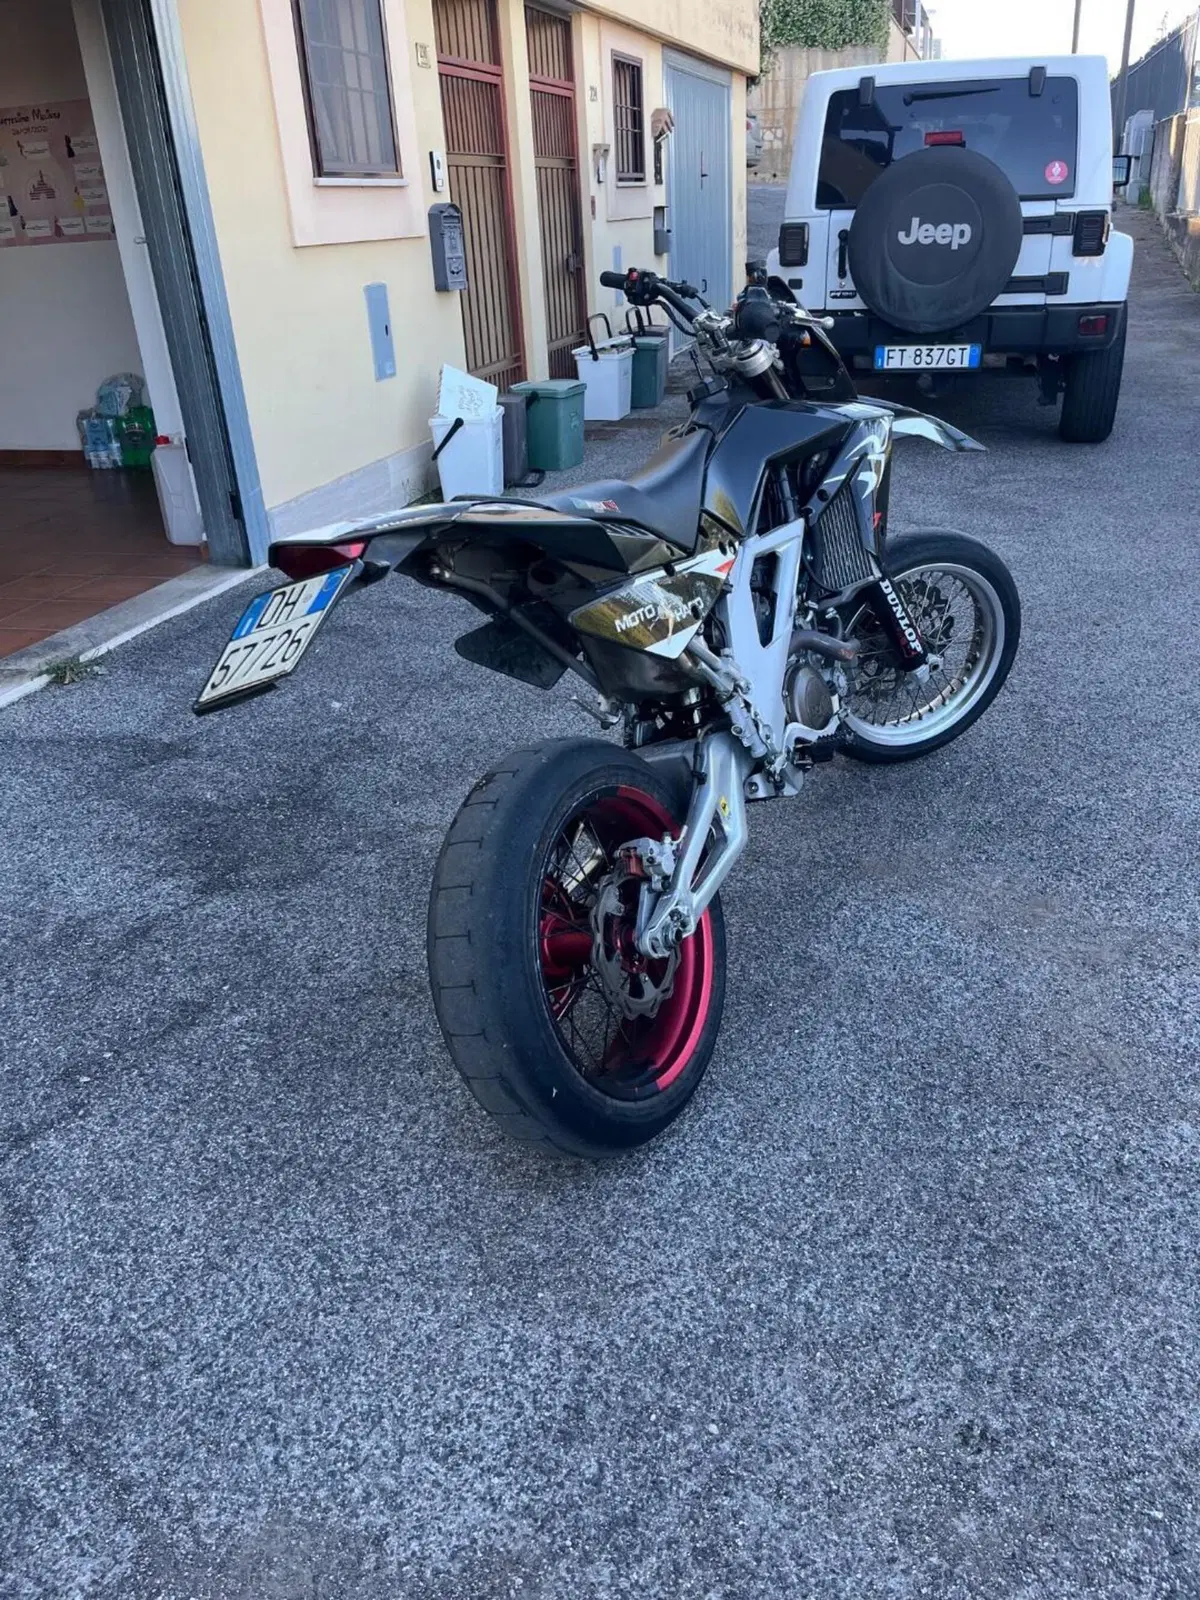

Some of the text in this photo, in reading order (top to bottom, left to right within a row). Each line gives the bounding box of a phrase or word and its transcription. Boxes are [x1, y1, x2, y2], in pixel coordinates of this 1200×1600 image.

[898, 216, 971, 250] Jeep
[886, 348, 907, 367] FT
[913, 347, 968, 366] 837GT
[255, 583, 309, 630] DH
[614, 603, 656, 633] MOTO
[879, 578, 924, 655] DUNLOP
[211, 622, 311, 691] 57726
